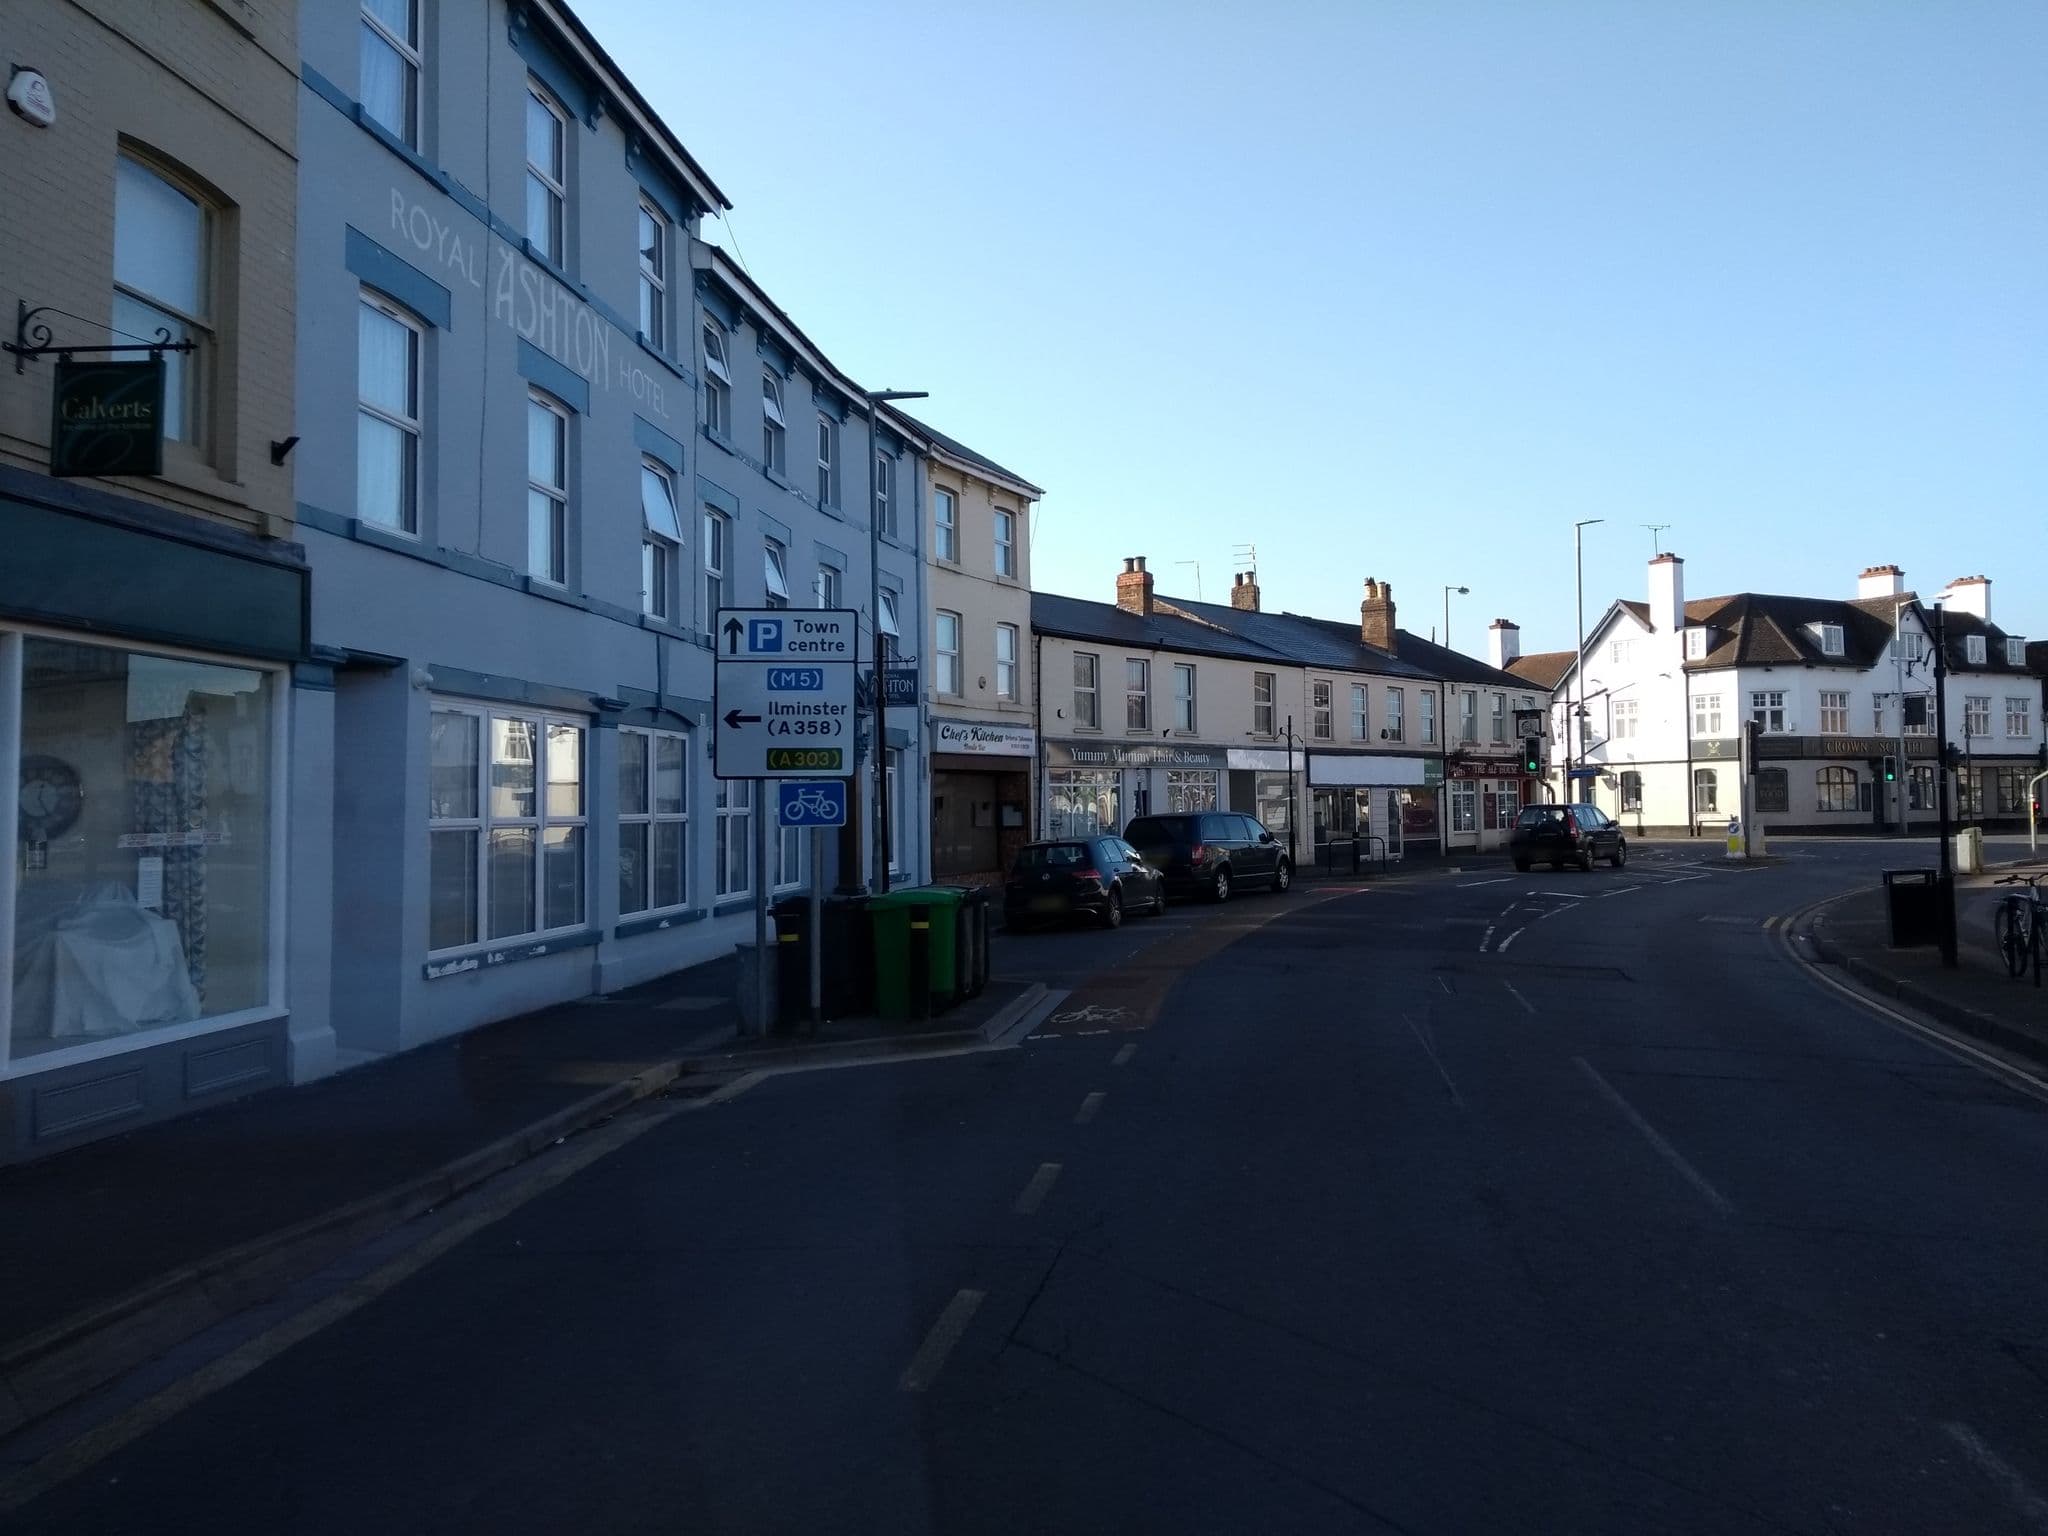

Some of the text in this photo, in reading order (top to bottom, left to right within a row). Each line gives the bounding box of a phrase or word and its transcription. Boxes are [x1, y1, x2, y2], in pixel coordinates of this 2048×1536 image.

[392, 188, 669, 419] ROYAL ASHTON HOTEL
[61, 395, 152, 419] Calverts
[793, 619, 839, 633] Town
[757, 623, 777, 648] P
[788, 638, 845, 652] centre
[770, 670, 820, 688] (M5)
[768, 701, 847, 716] Ilminster
[767, 719, 842, 736] (A358)
[941, 724, 968, 742] Chef's
[971, 727, 1004, 743] Kitchen
[769, 750, 840, 767] (A303)
[1070, 748, 1211, 764] Yummy Mummy Hair & Beauty
